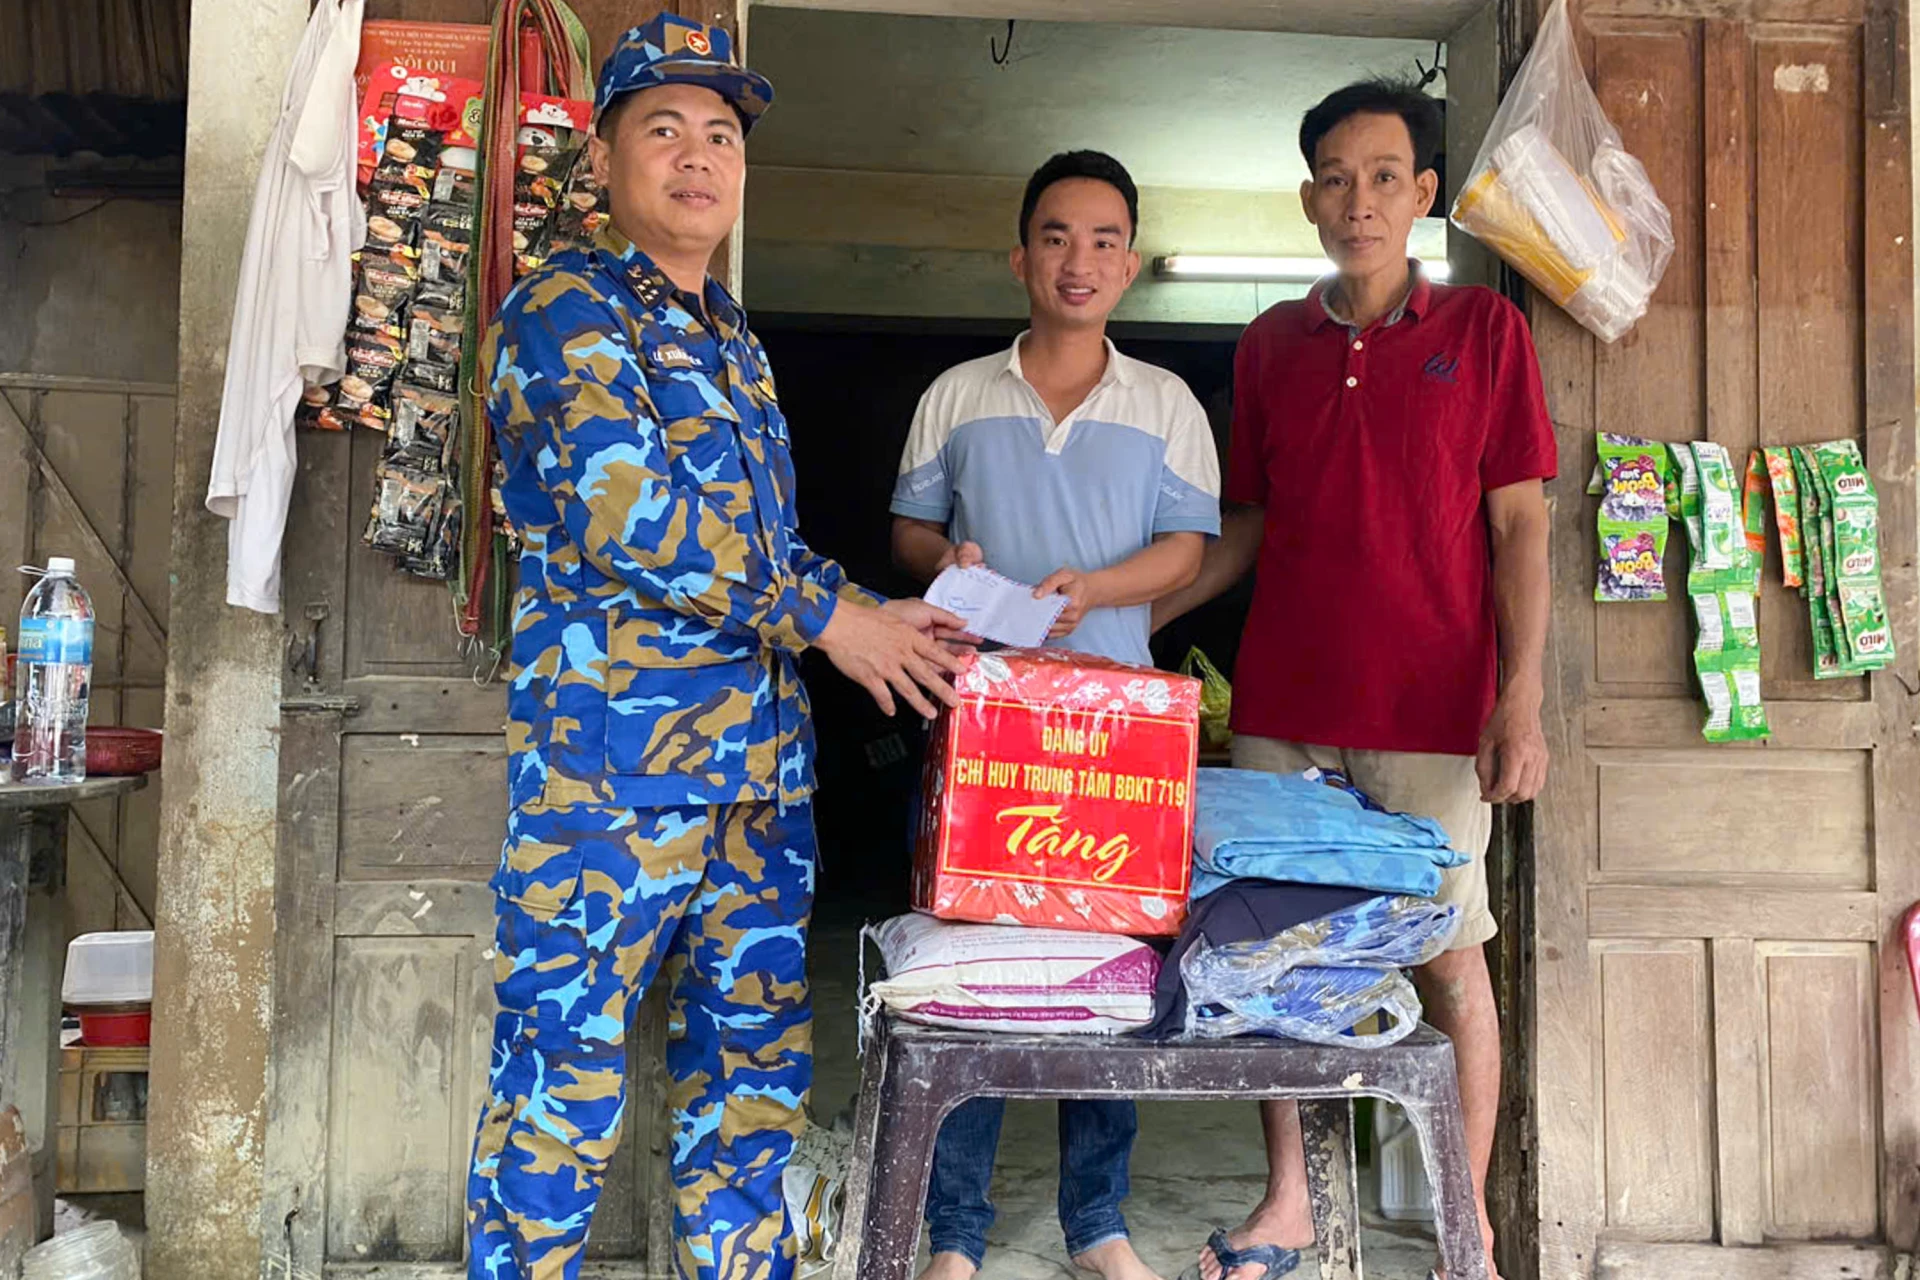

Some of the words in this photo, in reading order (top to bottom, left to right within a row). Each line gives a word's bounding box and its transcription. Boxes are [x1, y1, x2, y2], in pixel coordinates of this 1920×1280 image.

[1837, 475, 1865, 488] MILO
[1845, 554, 1874, 570] MILO
[1859, 633, 1886, 647] MILO
[957, 751, 986, 785] CHỈ
[988, 760, 1019, 789] HUY
[1023, 763, 1073, 794] TRUNG
[1078, 765, 1111, 799] TÂM
[1157, 778, 1185, 807] 719
[996, 804, 1140, 882] Tặng
